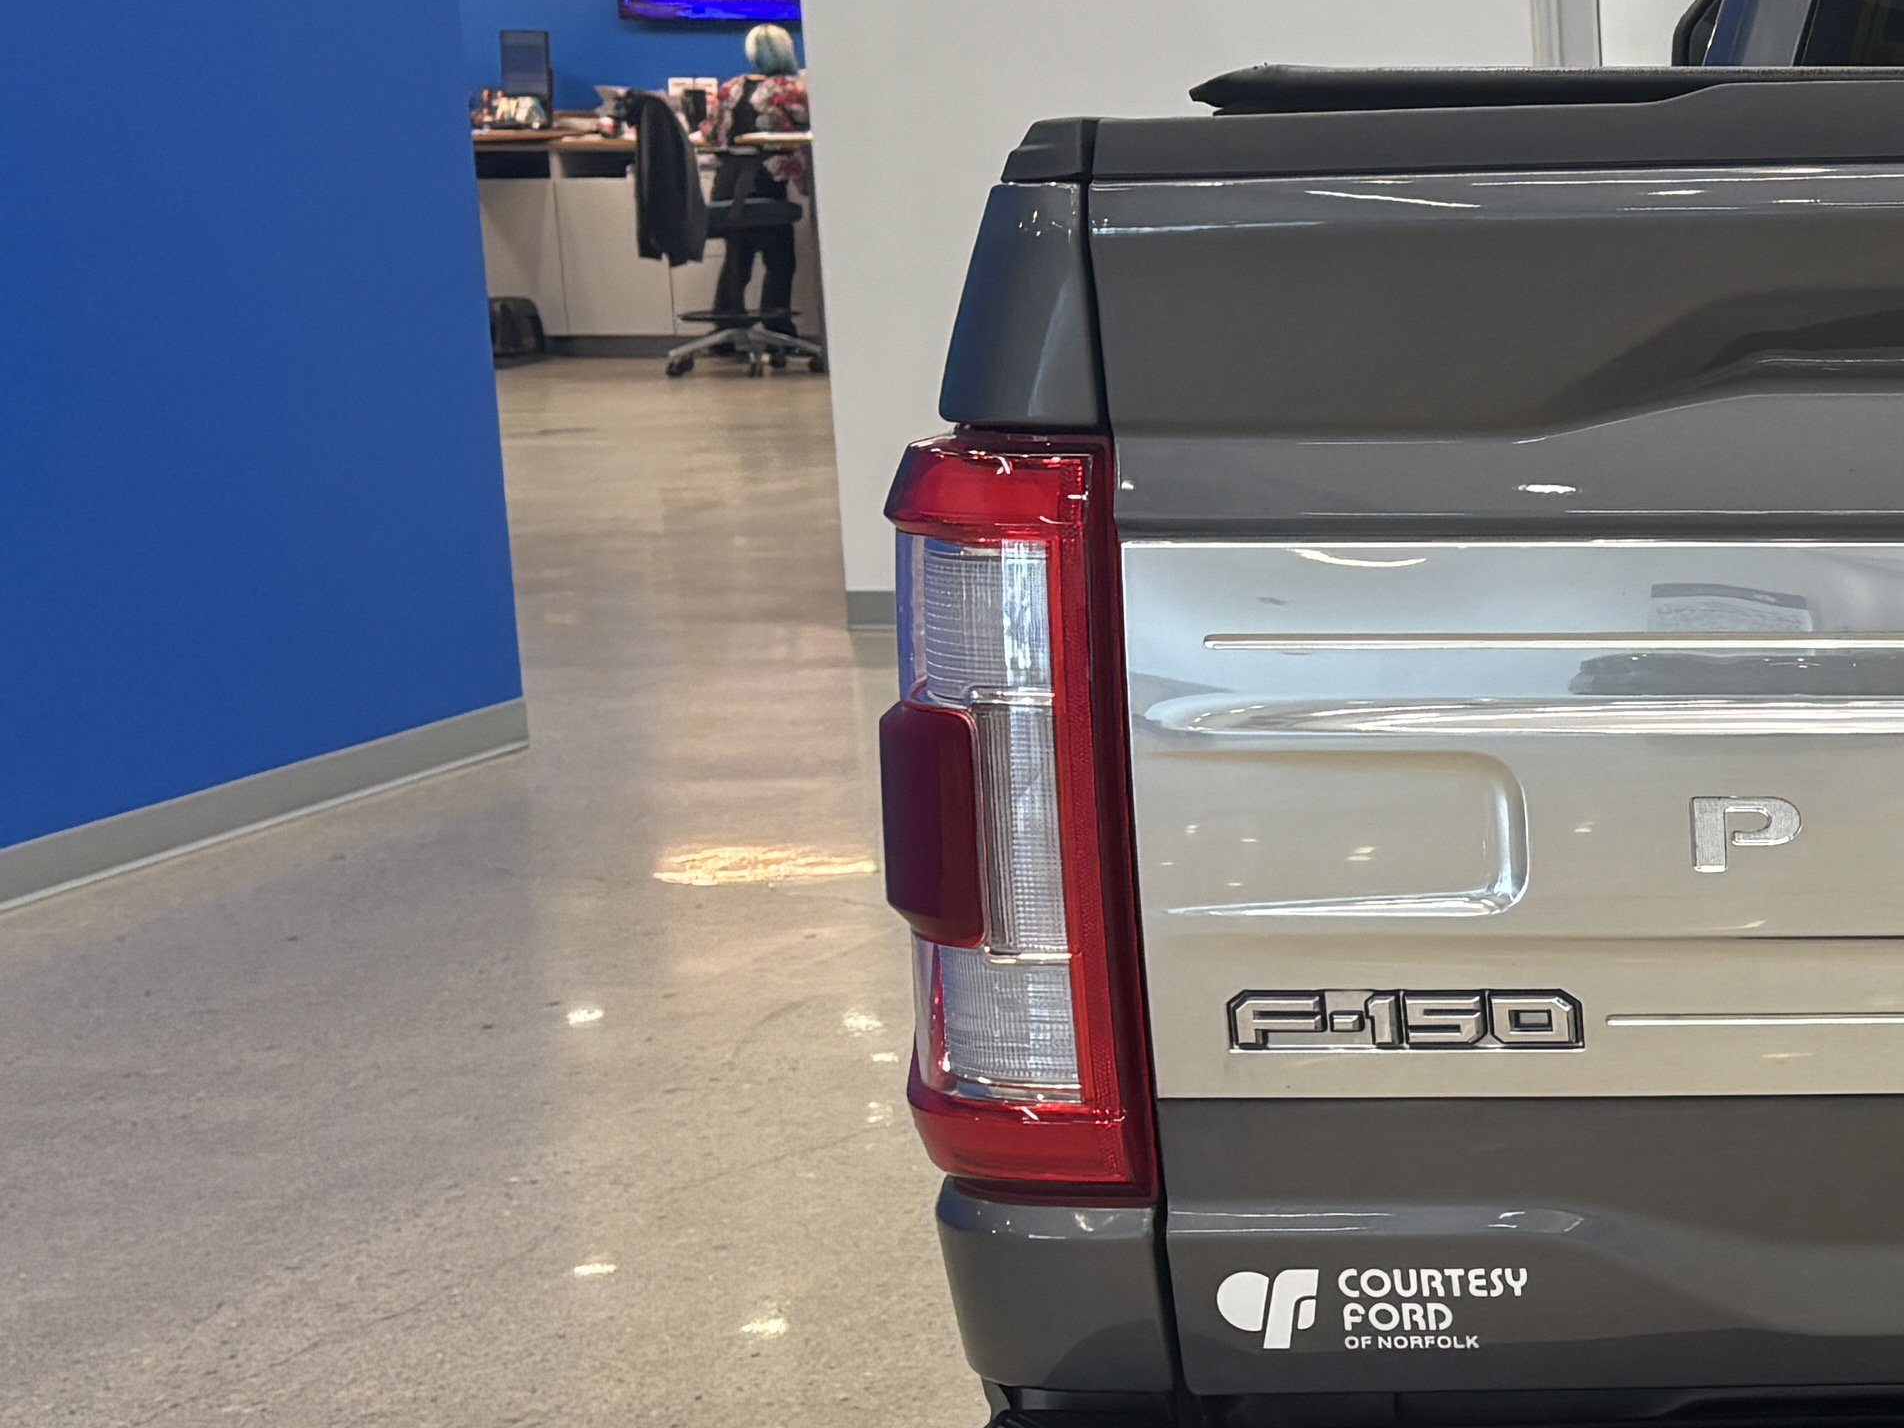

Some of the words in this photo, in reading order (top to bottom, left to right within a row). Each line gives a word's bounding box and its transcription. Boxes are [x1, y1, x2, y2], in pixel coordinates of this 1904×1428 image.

[1226, 989, 1586, 1054] F-150
[1338, 1268, 1528, 1298] COURTESY
[1343, 1302, 1453, 1332] FORD
[1344, 1335, 1372, 1349] OF
[1378, 1335, 1480, 1350] NORFOLK
